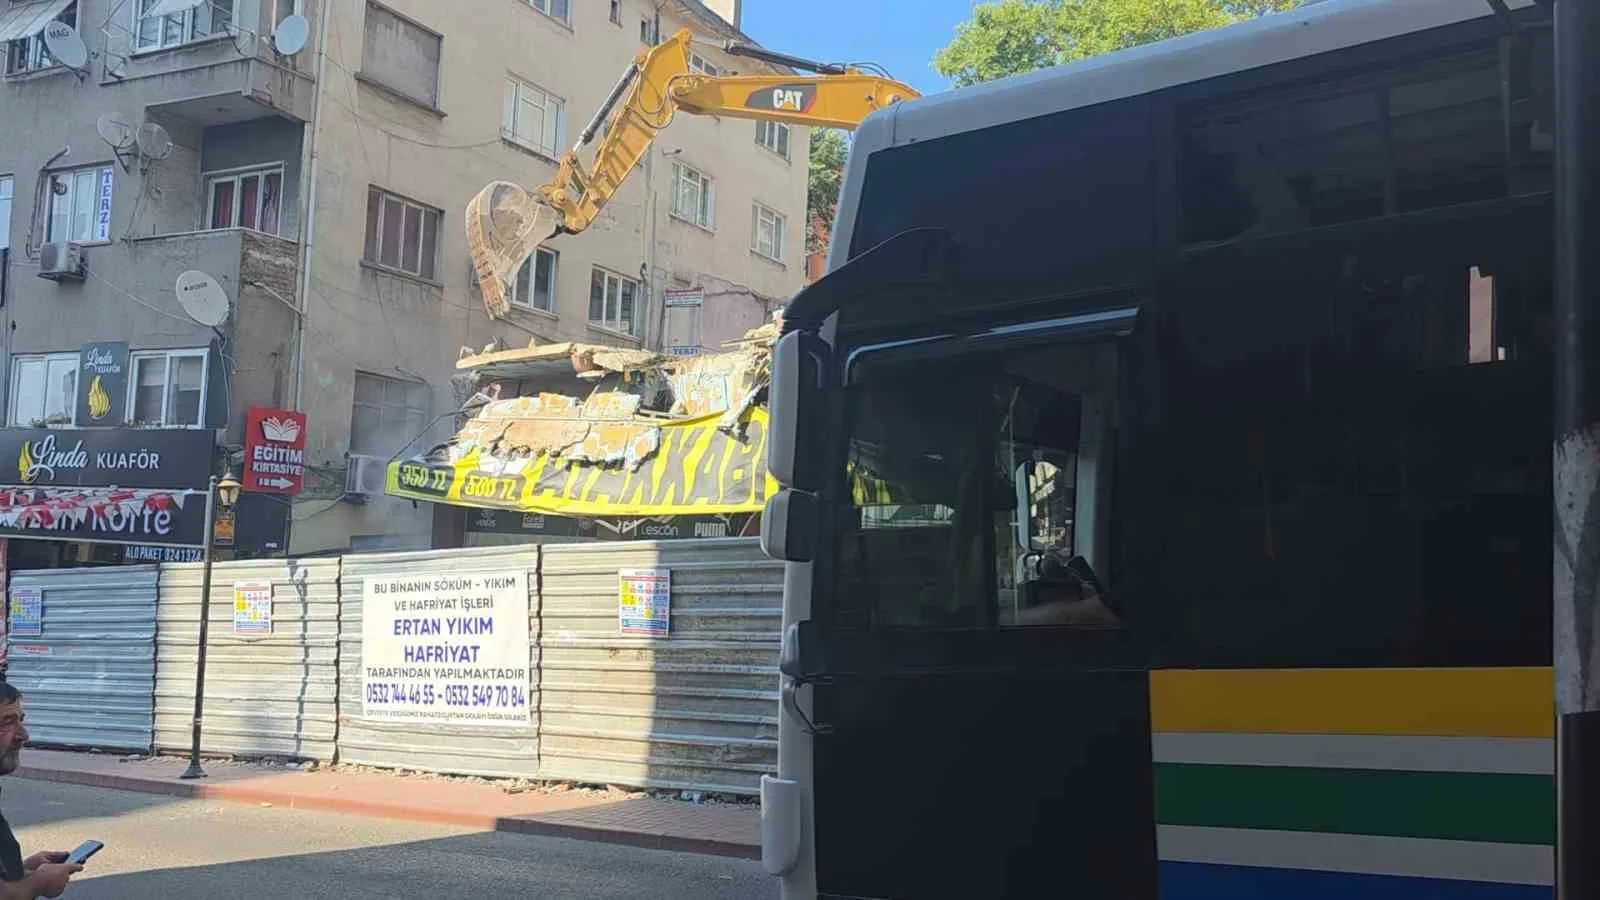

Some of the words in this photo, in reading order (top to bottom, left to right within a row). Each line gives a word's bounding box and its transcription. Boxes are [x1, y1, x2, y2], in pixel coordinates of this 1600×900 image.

[773, 89, 802, 111] CAT
[26, 434, 90, 482] Linda
[96, 448, 160, 469] KUAFÖR
[253, 444, 303, 463] EĞİTİM
[252, 460, 303, 476] KIRTASİYE
[431, 469, 447, 490] TL
[499, 479, 517, 500] TL
[695, 522, 726, 537] PUMA
[374, 583, 387, 593] BU
[390, 581, 431, 592] BİNANIN
[434, 577, 472, 590] SÖKÜM
[484, 577, 516, 588] YIKIM
[394, 600, 407, 611] VE
[409, 598, 458, 610] HAFRİYAT
[461, 595, 494, 612] İŞLERİ
[393, 617, 441, 635] ERTAN
[447, 617, 493, 635] YIKIM
[404, 641, 480, 663] HAFRİYAT
[366, 667, 431, 678] TARAFINDAN
[434, 668, 525, 680] YAPILMAKTADIR
[366, 683, 389, 703] 0532
[391, 683, 406, 703] 744
[409, 684, 420, 704] 46
[423, 684, 435, 705] 55
[445, 685, 470, 706] 0532
[472, 686, 494, 707] 549
[496, 686, 509, 707] 70
[511, 687, 525, 707] 84
